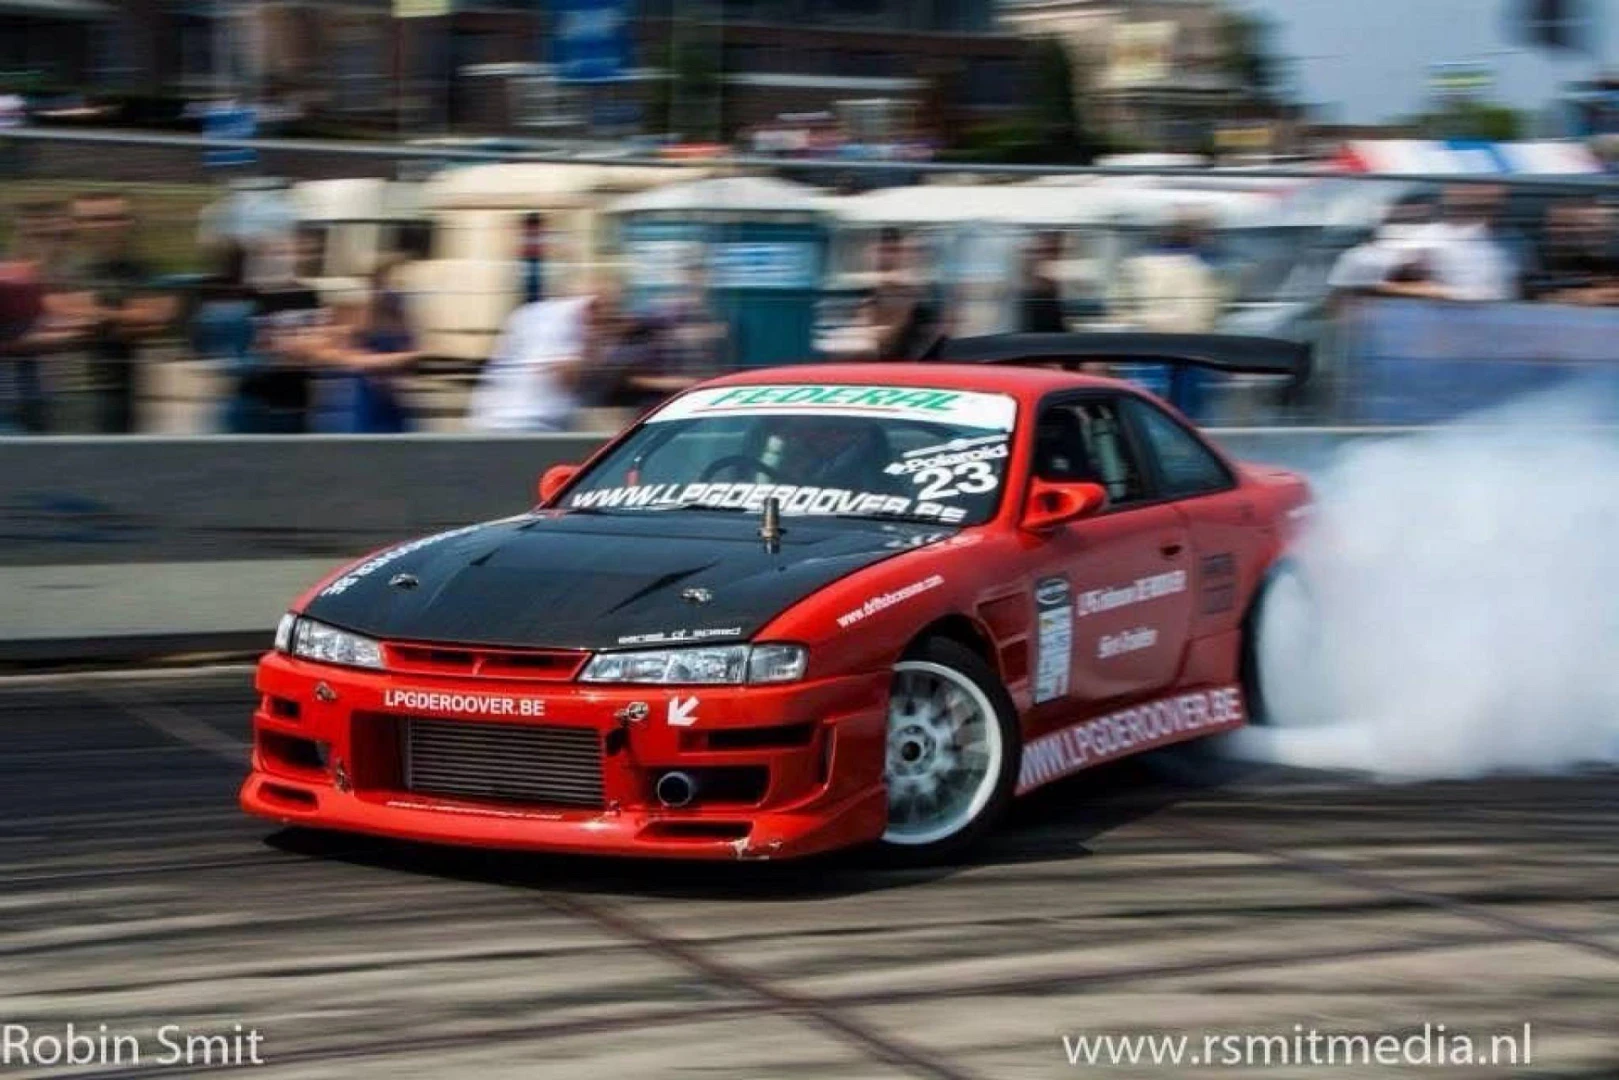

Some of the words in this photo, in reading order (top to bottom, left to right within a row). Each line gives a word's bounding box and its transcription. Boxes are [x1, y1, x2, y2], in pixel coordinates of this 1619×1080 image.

[710, 386, 960, 411] FEDERAL
[912, 460, 999, 501] 23
[384, 689, 546, 717] LPGDEROOVER.BE
